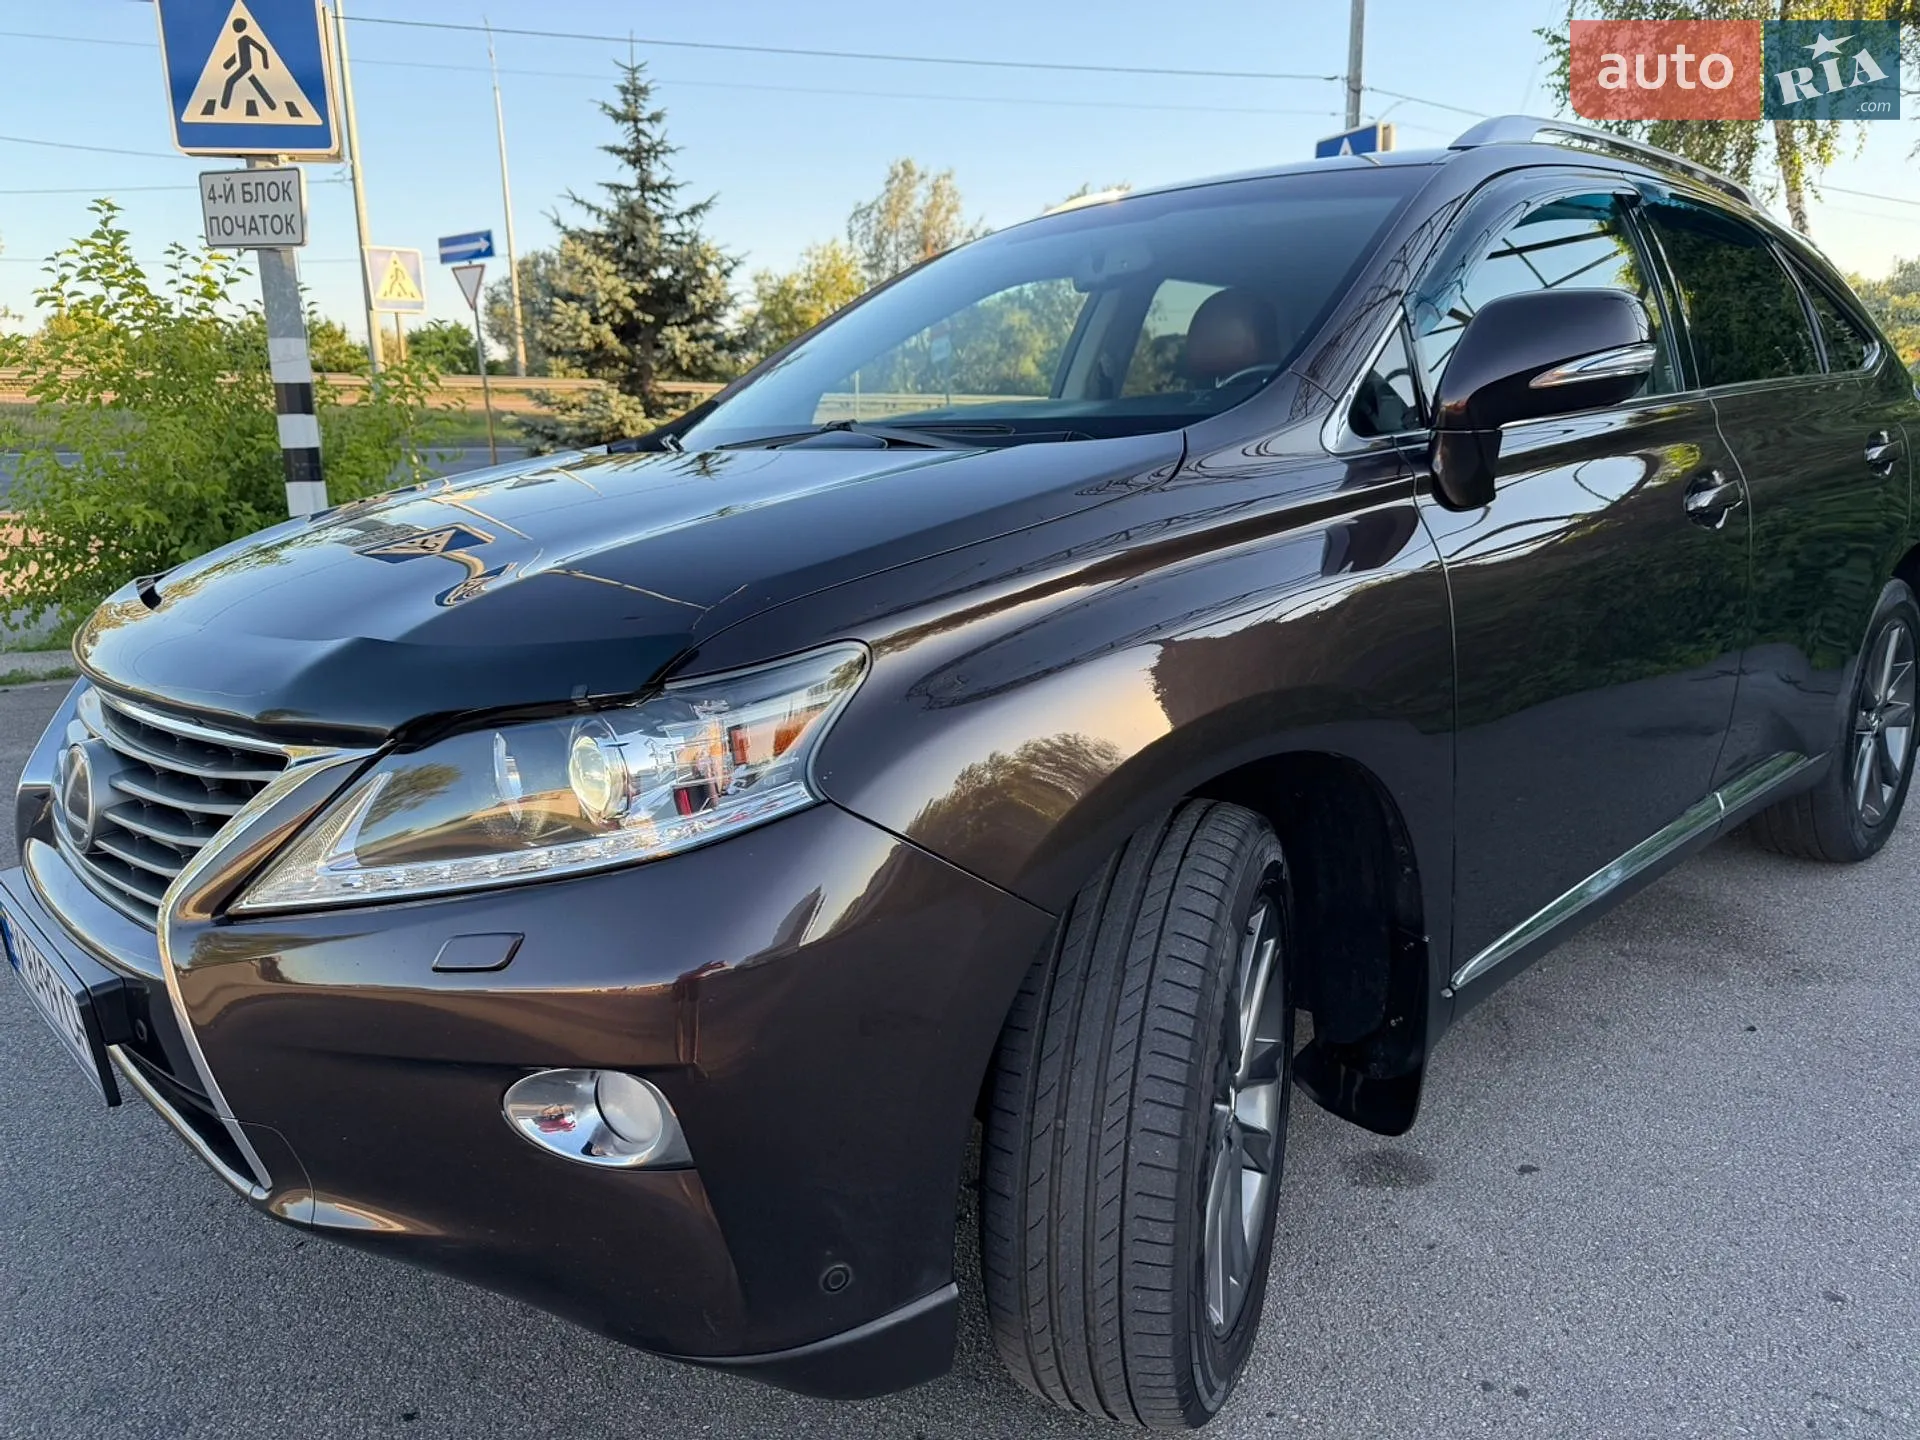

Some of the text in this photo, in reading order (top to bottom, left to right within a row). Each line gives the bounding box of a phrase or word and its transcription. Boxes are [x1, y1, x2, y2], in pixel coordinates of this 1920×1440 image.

[207, 176, 292, 204] 4-Й БЛОК
[208, 213, 295, 237] ПОЧАТОК
